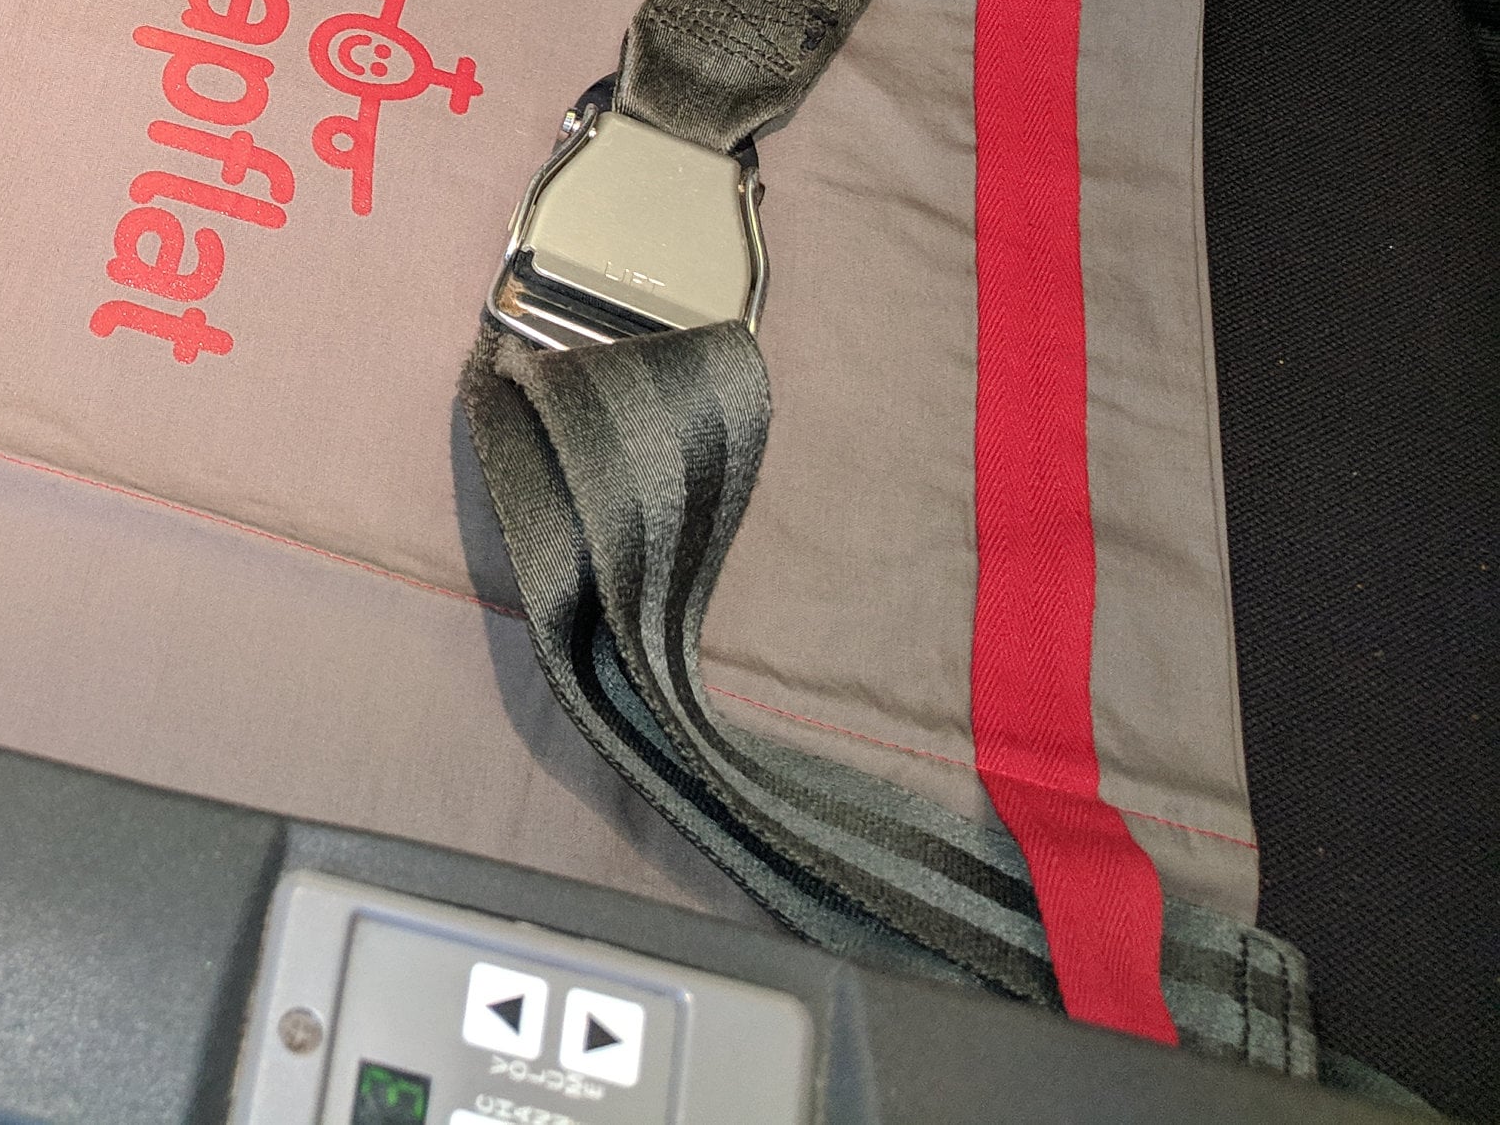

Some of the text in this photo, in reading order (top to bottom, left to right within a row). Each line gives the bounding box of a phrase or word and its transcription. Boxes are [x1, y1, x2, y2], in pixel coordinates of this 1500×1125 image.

[604, 260, 667, 295] LIFT
[490, 1055, 605, 1099] VOLUME
[475, 1093, 574, 1125] CHANN
